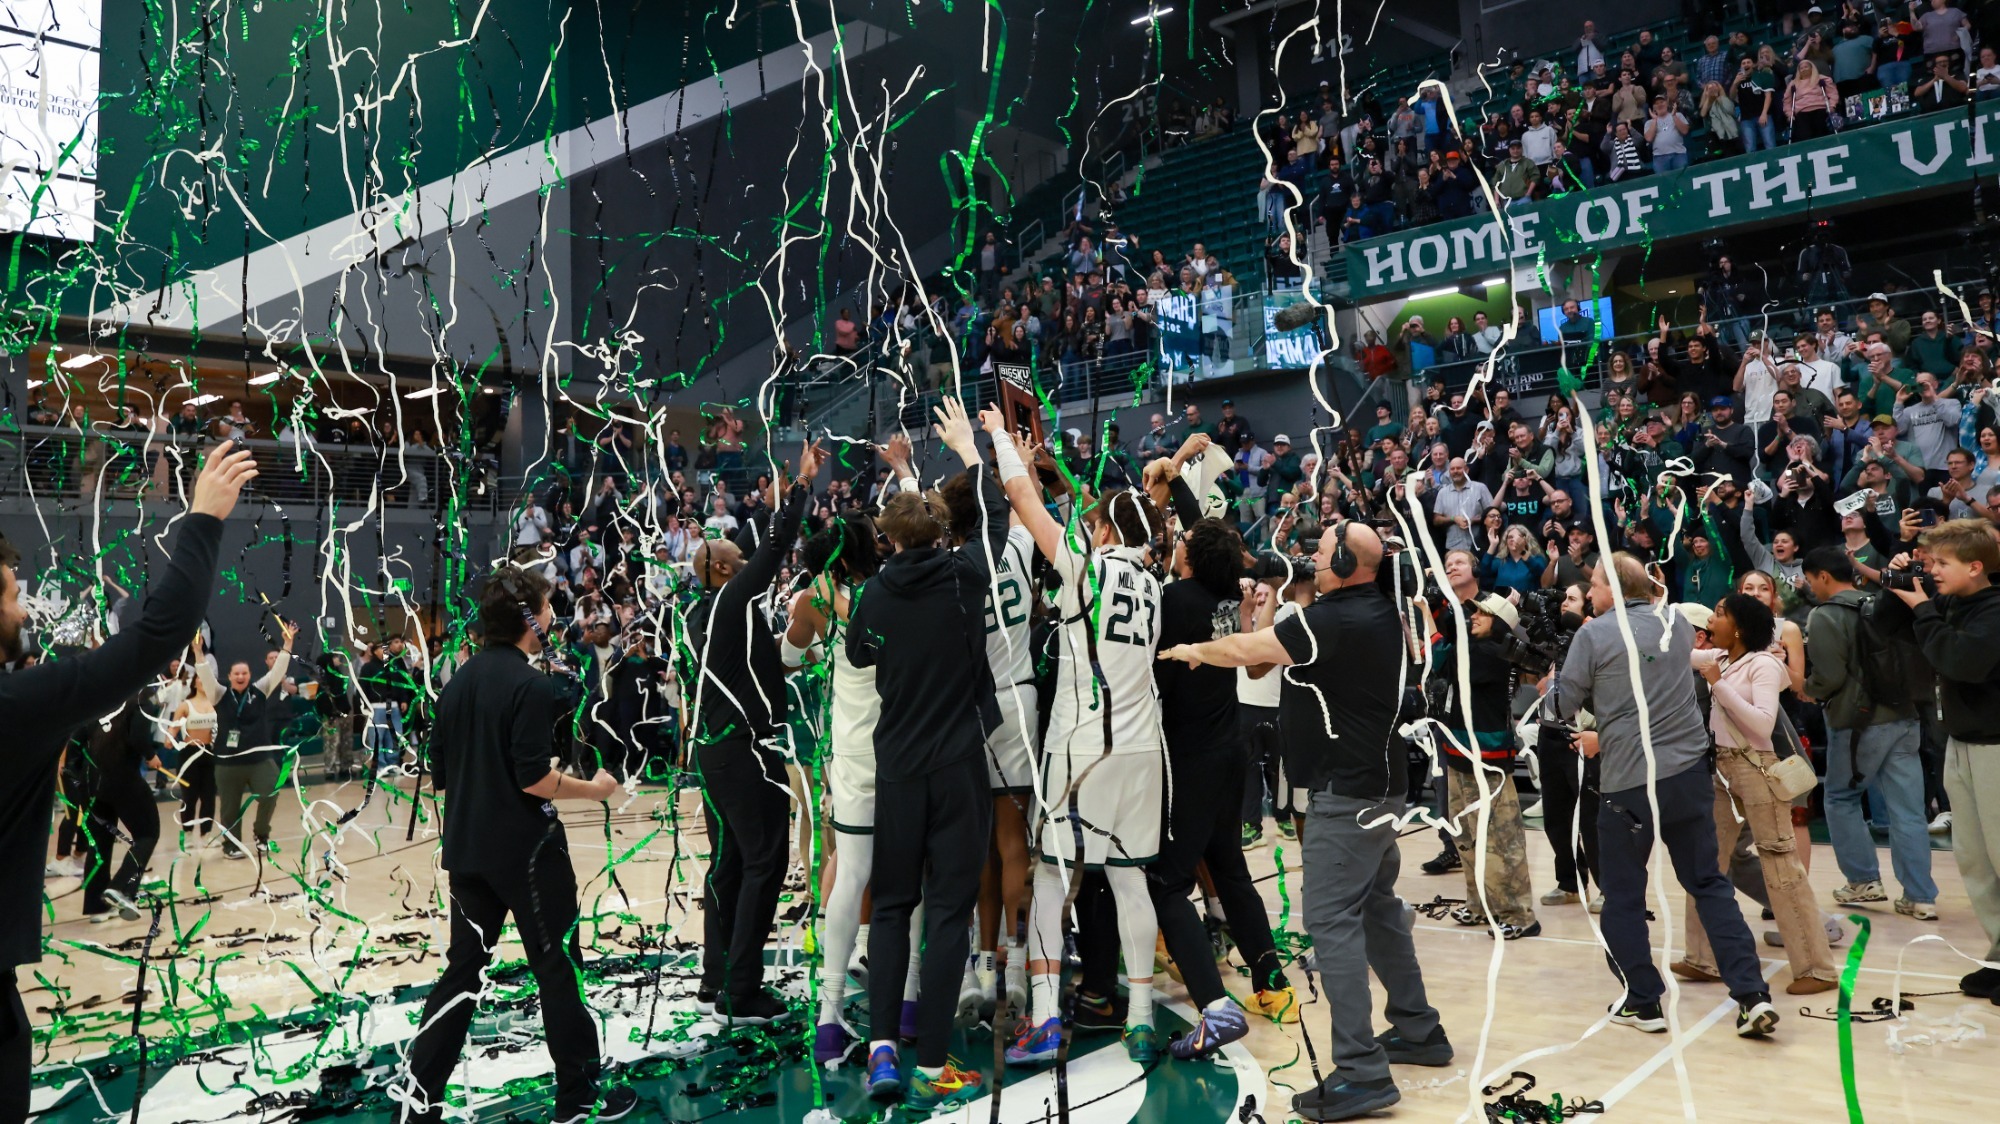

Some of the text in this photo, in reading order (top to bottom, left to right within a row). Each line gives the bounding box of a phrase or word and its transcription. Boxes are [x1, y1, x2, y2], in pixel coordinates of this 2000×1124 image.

[1311, 34, 1354, 64] 212
[1122, 95, 1158, 122] 213
[1364, 112, 2000, 287] HOME OF THE VI
[1507, 501, 1538, 516] PSU
[1105, 592, 1156, 647] 23
